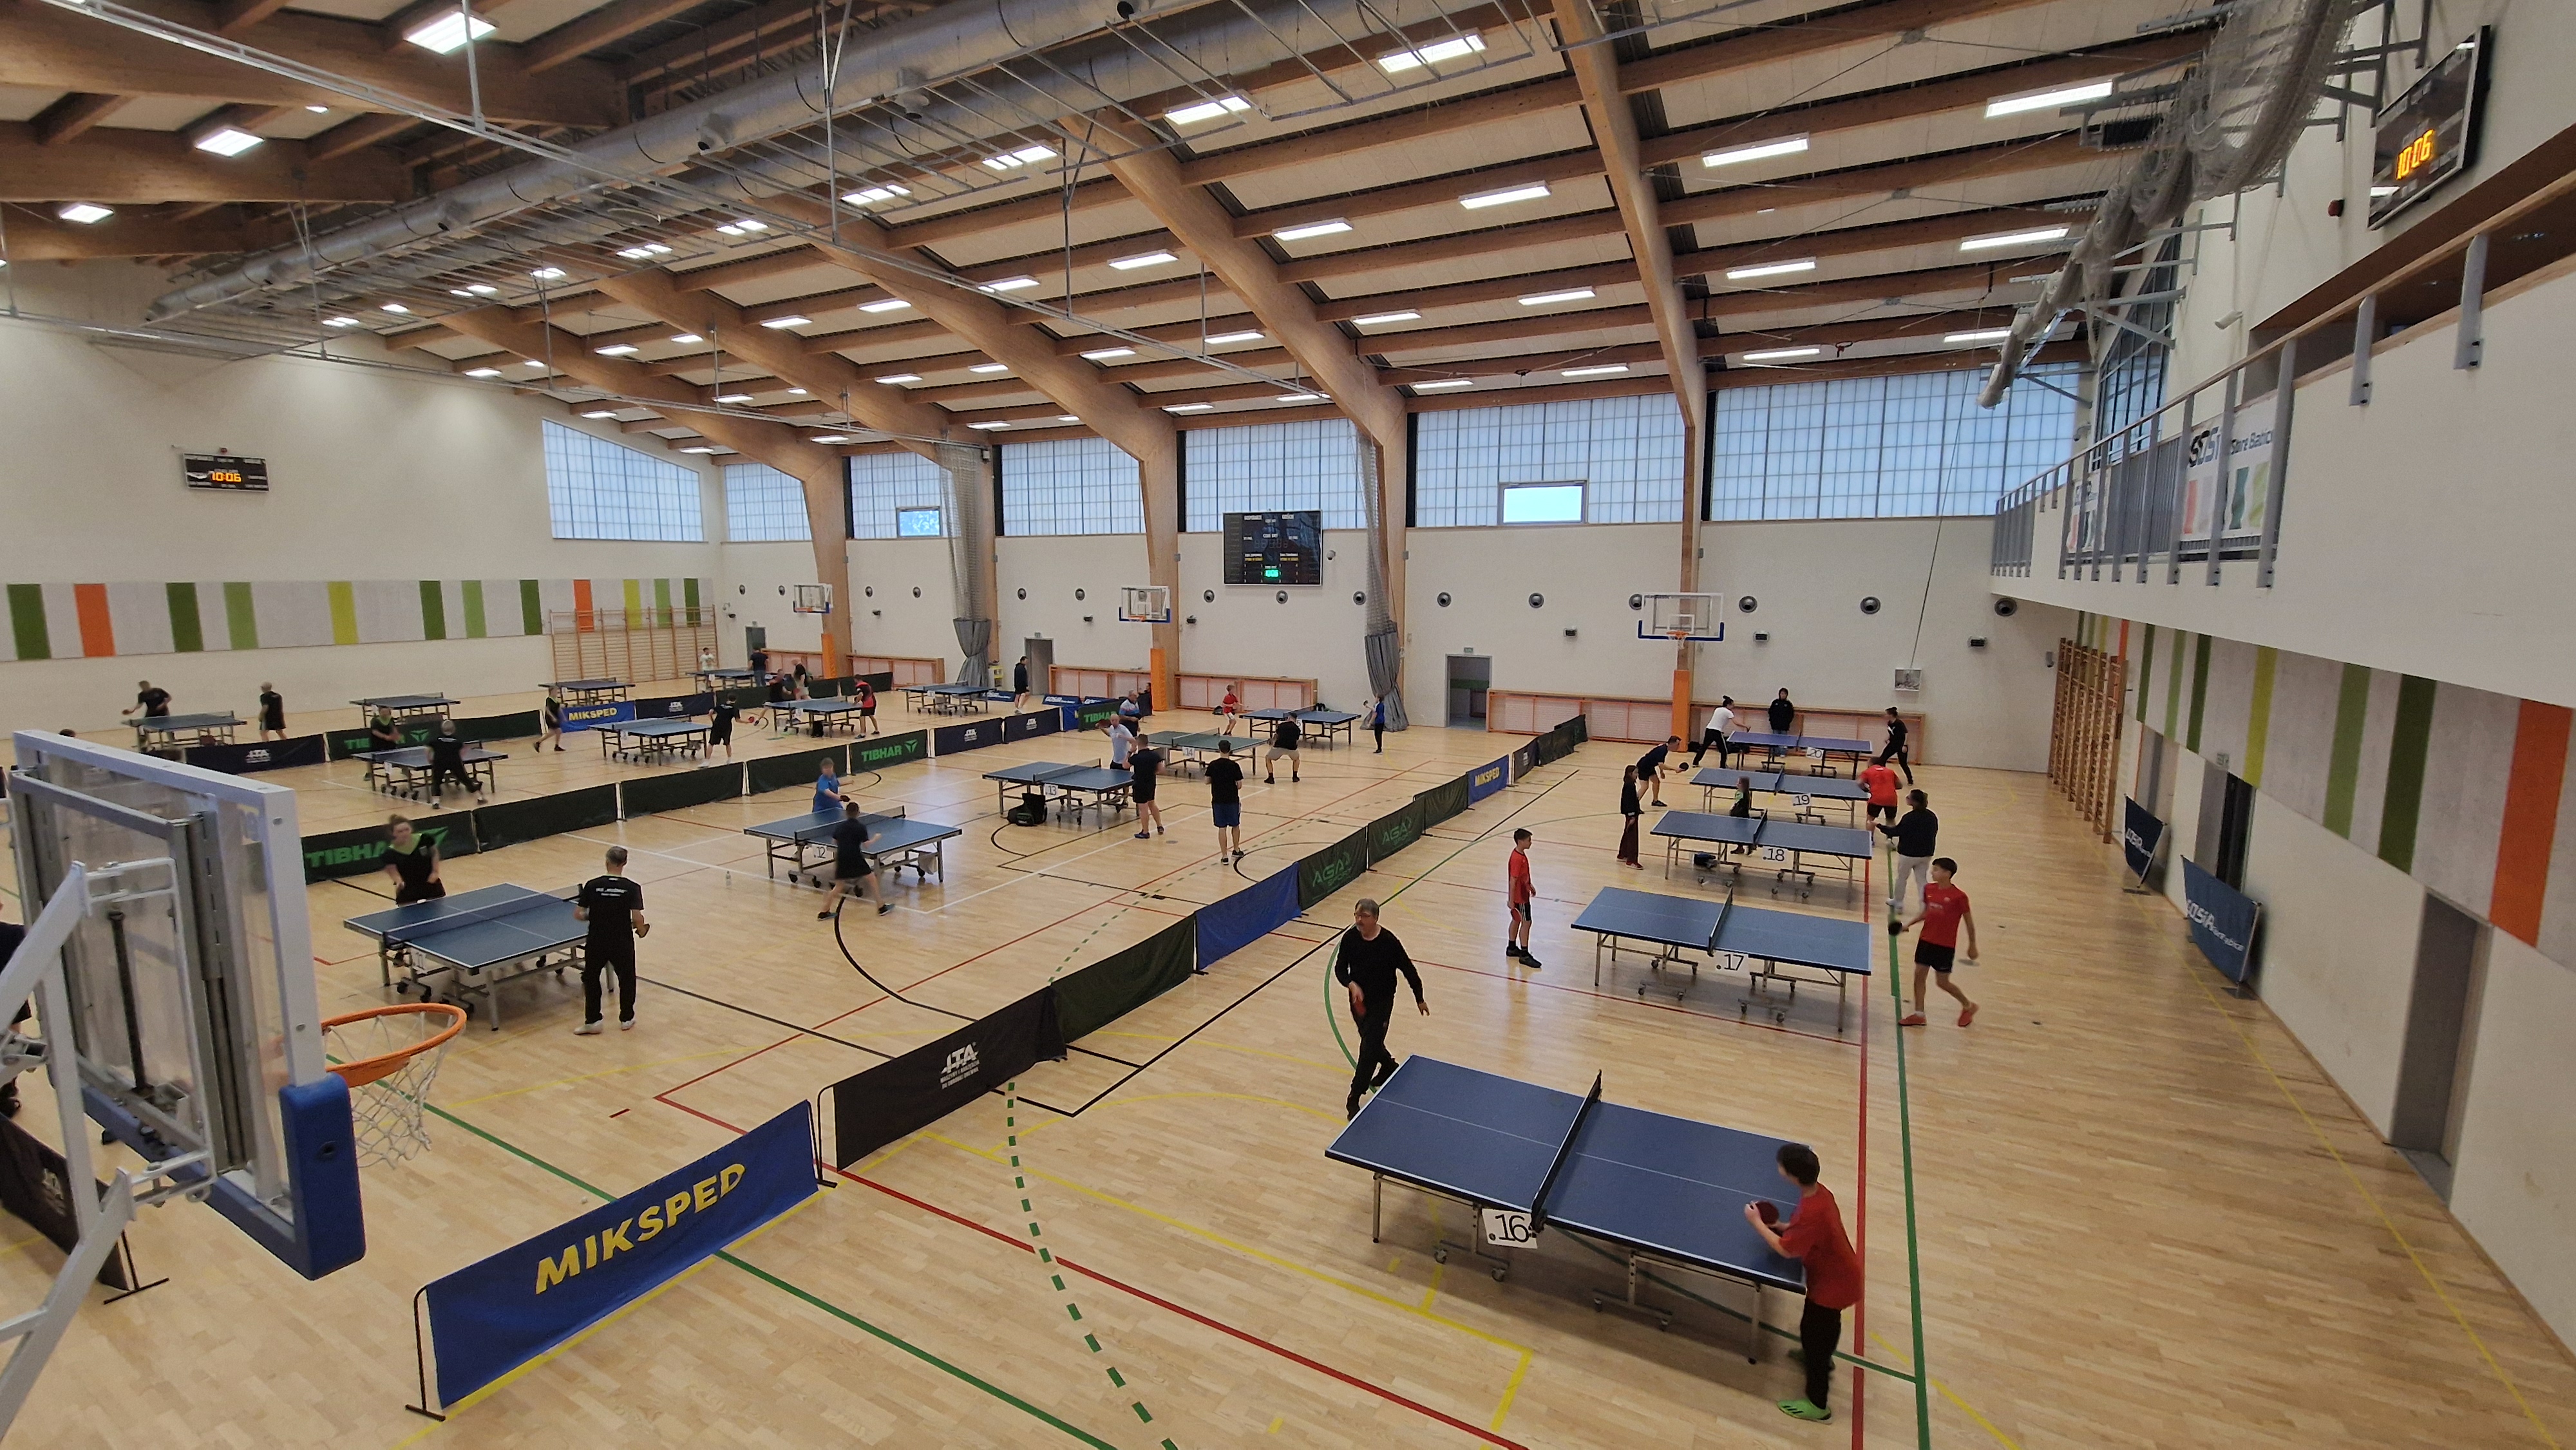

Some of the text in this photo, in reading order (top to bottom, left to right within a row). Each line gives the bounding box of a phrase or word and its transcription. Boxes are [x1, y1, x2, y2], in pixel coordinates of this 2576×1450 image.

[569, 708, 618, 720] MIKSPED
[861, 745, 902, 762] TIBHAR
[1475, 767, 1501, 787] MIKSPED
[305, 840, 388, 868] TIBHA
[536, 1163, 746, 1295] MIKSPED
